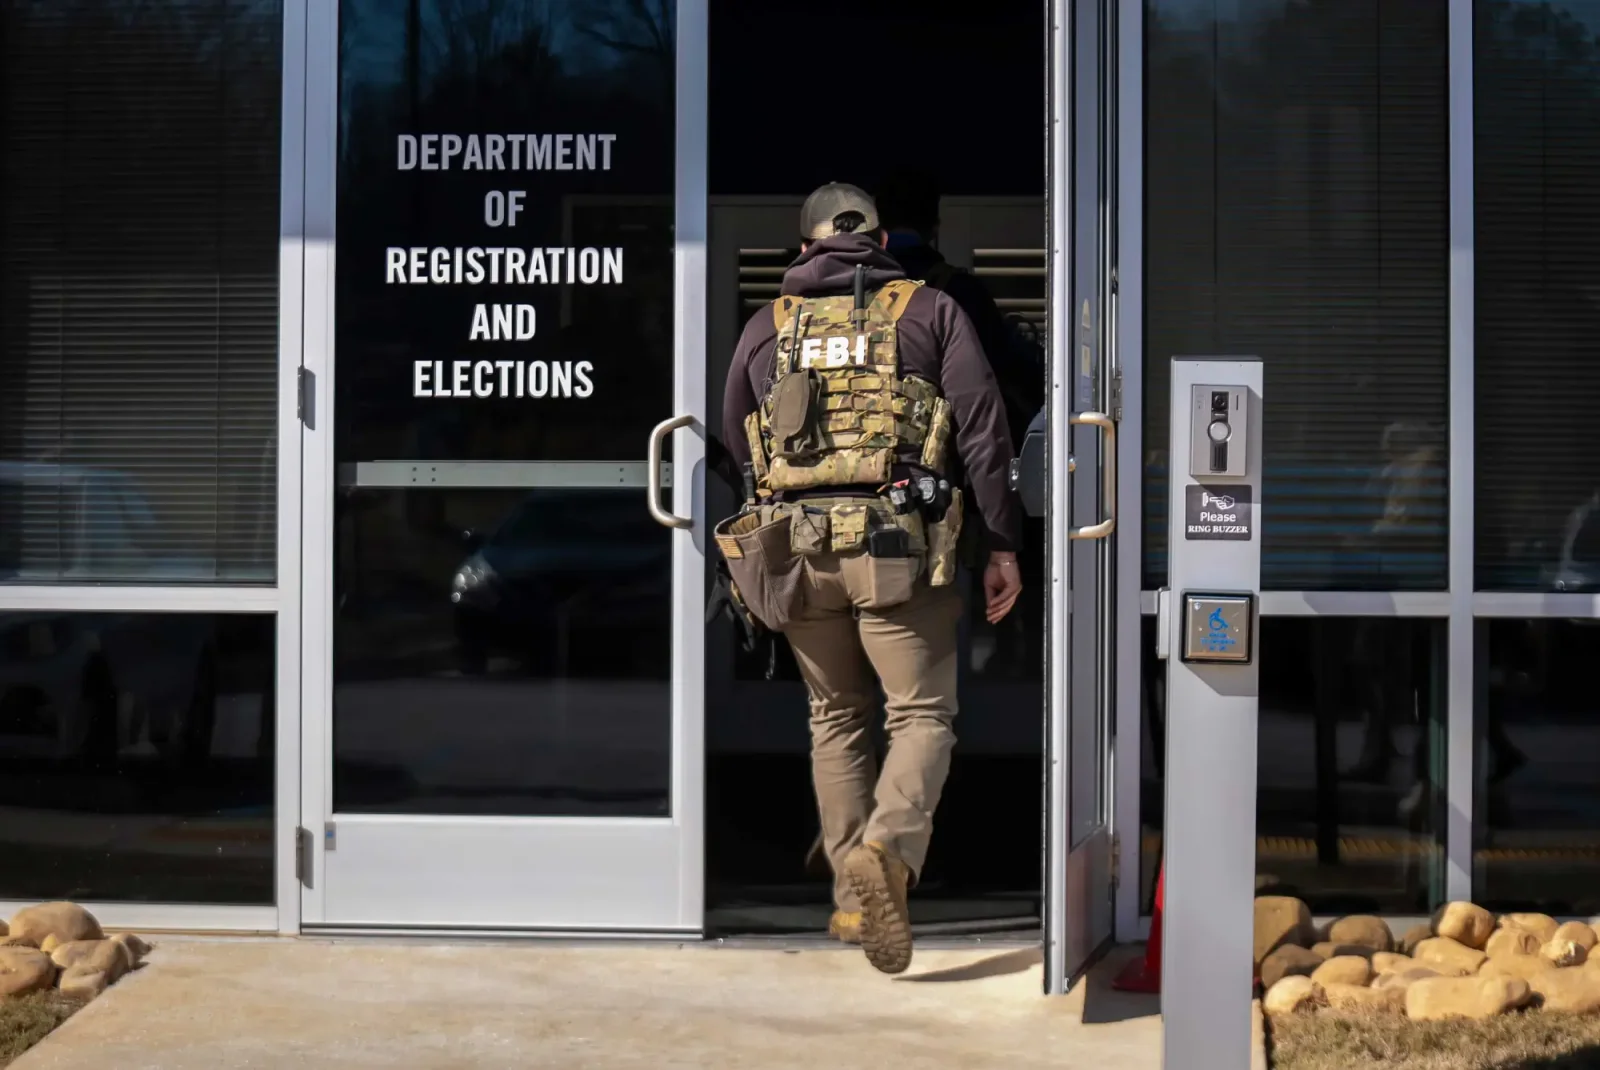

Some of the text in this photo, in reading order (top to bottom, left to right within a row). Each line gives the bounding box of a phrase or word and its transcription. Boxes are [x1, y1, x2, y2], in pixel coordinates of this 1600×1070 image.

[397, 133, 617, 170] DEPARTMENT
[484, 190, 527, 227] OF
[386, 247, 623, 284] REGISTRATION
[469, 303, 536, 341] AND
[801, 335, 865, 368] FBI
[413, 360, 594, 398] ELECTIONS
[1188, 525, 1248, 534] RING BUZZER
[1200, 511, 1236, 522] Please
